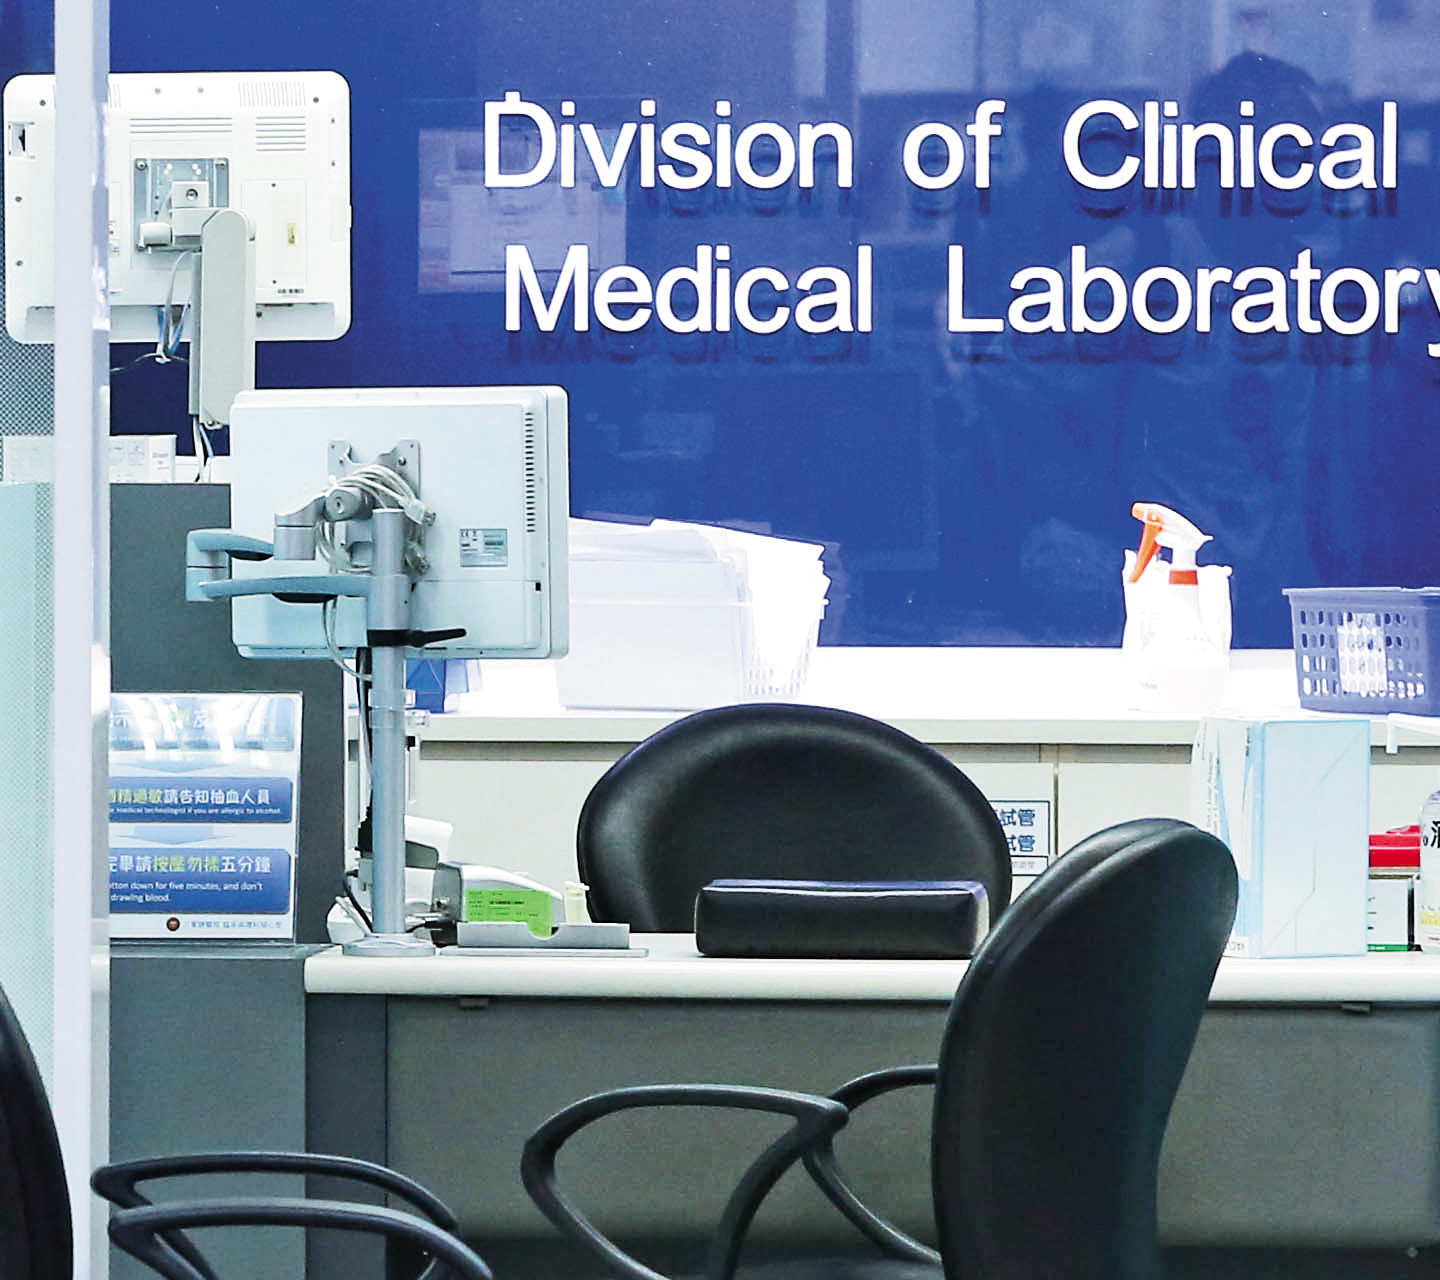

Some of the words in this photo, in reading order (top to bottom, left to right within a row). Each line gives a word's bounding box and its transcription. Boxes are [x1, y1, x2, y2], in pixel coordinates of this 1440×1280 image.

[484, 92, 853, 189] Division
[902, 100, 1006, 190] of
[1062, 99, 1397, 190] Clinical
[504, 243, 872, 335] Medical
